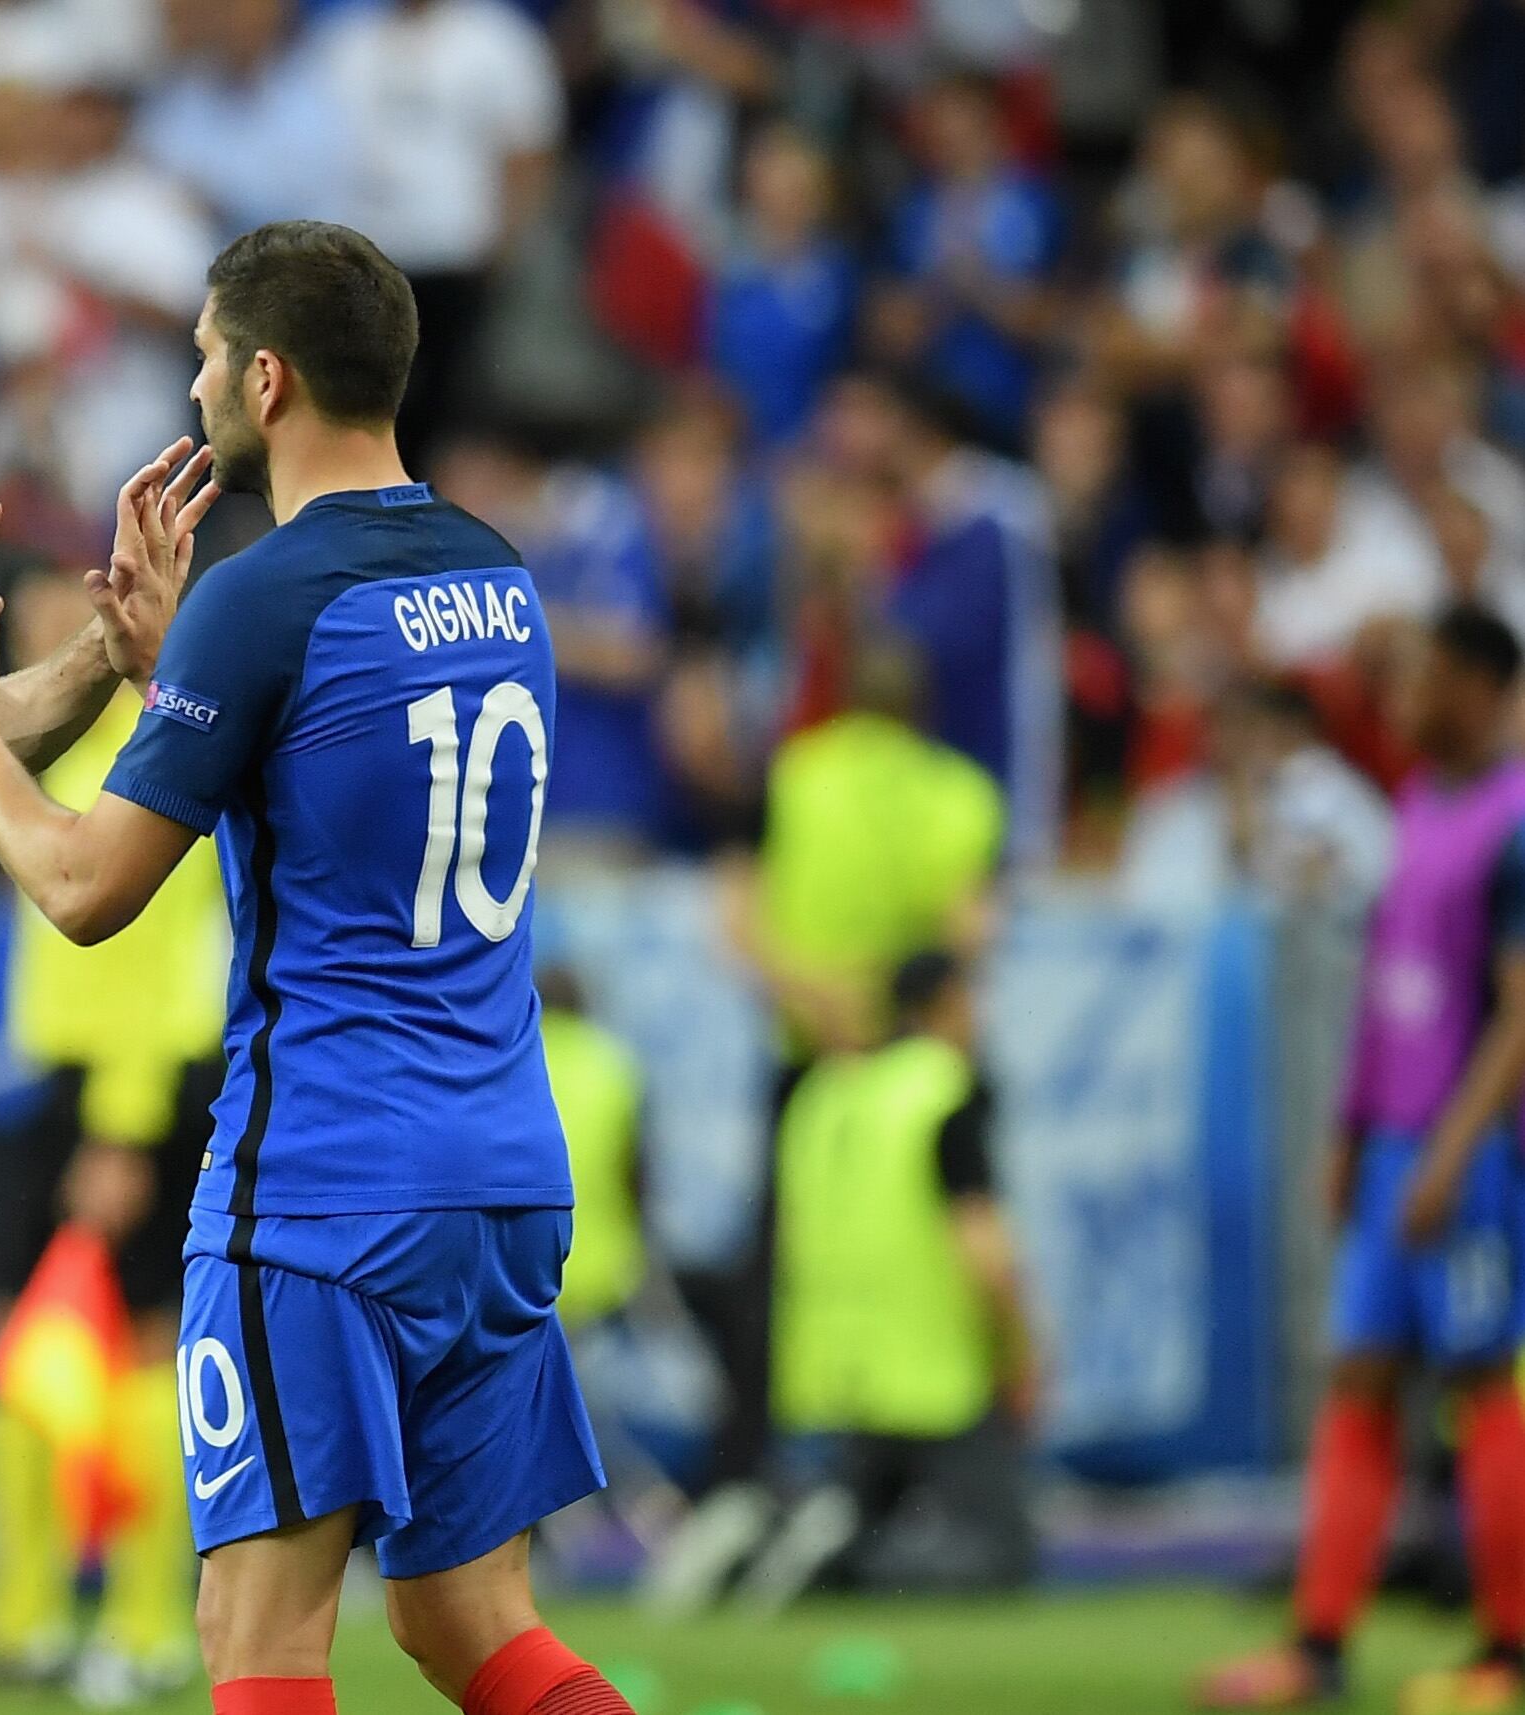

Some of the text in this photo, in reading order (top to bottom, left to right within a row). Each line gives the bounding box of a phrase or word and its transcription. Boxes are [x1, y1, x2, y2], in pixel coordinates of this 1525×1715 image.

[394, 581, 531, 652] GIGNAC
[407, 681, 547, 948] 10
[176, 1336, 246, 1457] 10
